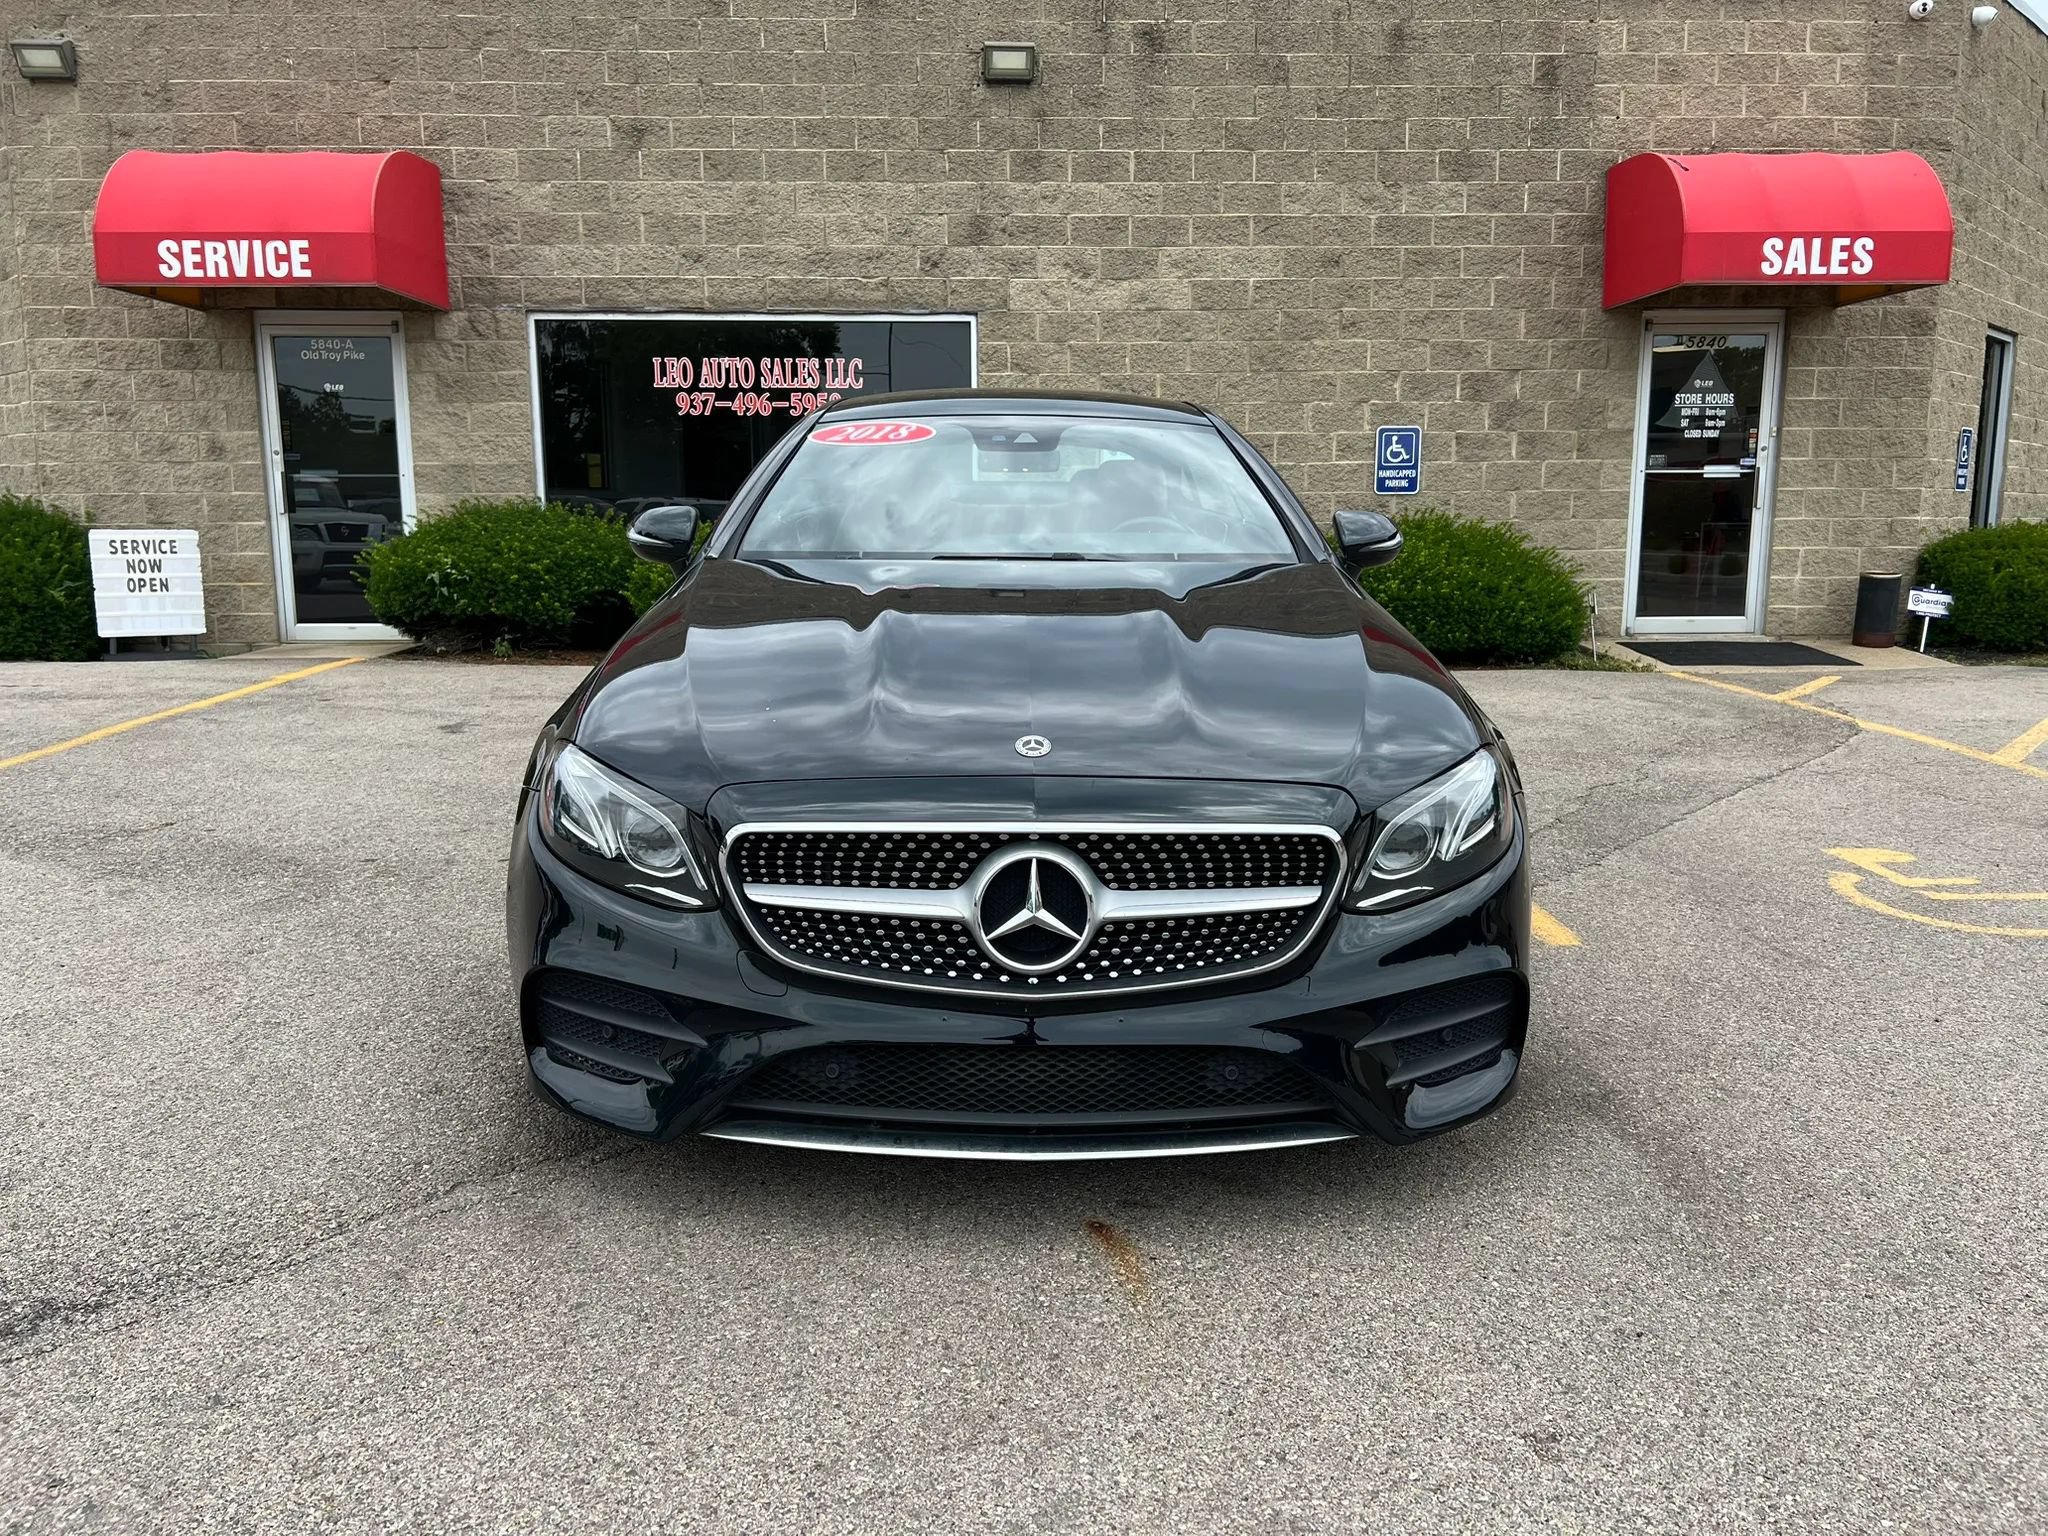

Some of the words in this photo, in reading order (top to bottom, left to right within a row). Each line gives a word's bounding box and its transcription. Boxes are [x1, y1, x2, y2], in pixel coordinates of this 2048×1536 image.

[157, 239, 312, 278] SERVICE
[1760, 237, 1875, 276] SALES
[310, 339, 353, 350] 5840-A
[1686, 336, 1727, 348] 5840
[301, 350, 319, 360] Old
[320, 350, 341, 362] Troy
[343, 350, 366, 360] Pike
[653, 357, 694, 388] LEO
[699, 356, 755, 388] AUTO
[760, 357, 820, 389] SALES
[825, 357, 863, 388] LLC
[1674, 393, 1703, 405] STORE
[1705, 393, 1735, 404] HOURS
[1680, 418, 1690, 427] SAT
[826, 425, 917, 441] 2018
[1684, 429, 1702, 438] CLOSED
[1702, 429, 1720, 438] SUNDAY
[1378, 469, 1416, 477] HANDICAPPED
[1385, 479, 1408, 487] PARKING
[108, 539, 178, 555] SERVICE
[126, 558, 162, 574] NOW
[126, 577, 170, 593] OPEN
